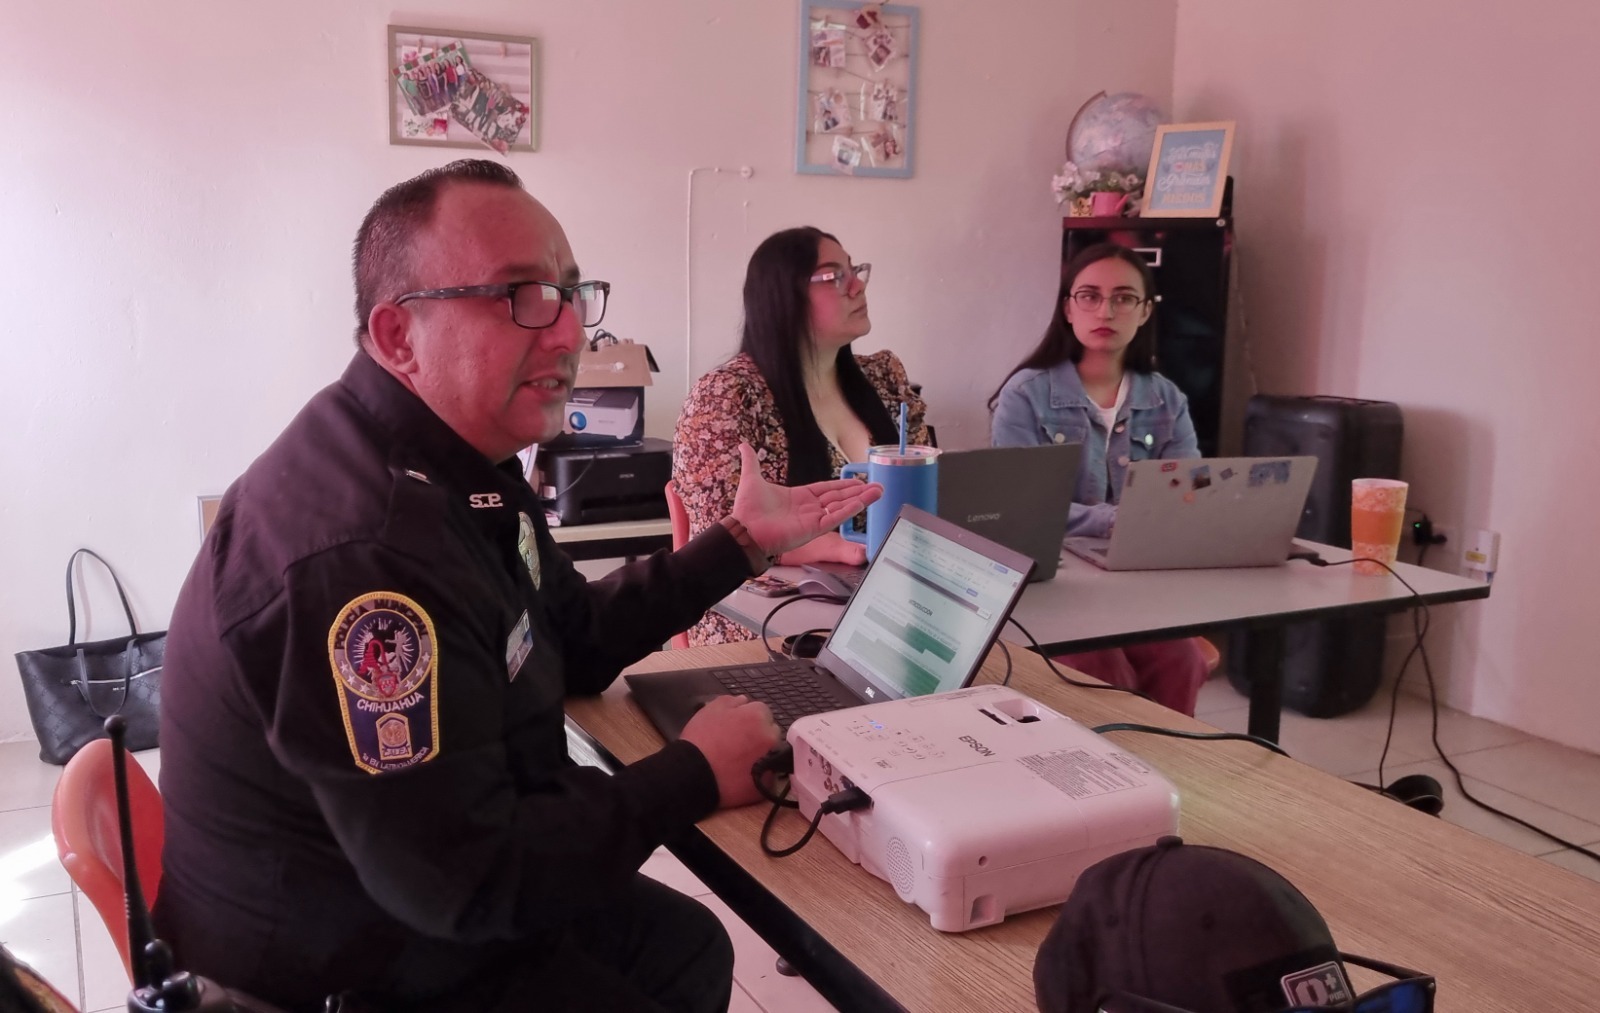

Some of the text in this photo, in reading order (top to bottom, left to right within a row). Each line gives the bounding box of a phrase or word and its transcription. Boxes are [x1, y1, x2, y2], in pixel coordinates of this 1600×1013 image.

[967, 513, 1000, 523] Lenovo
[865, 686, 876, 699] DELL
[356, 691, 425, 713] CHIHUAHUA
[958, 734, 995, 758] EPSON
